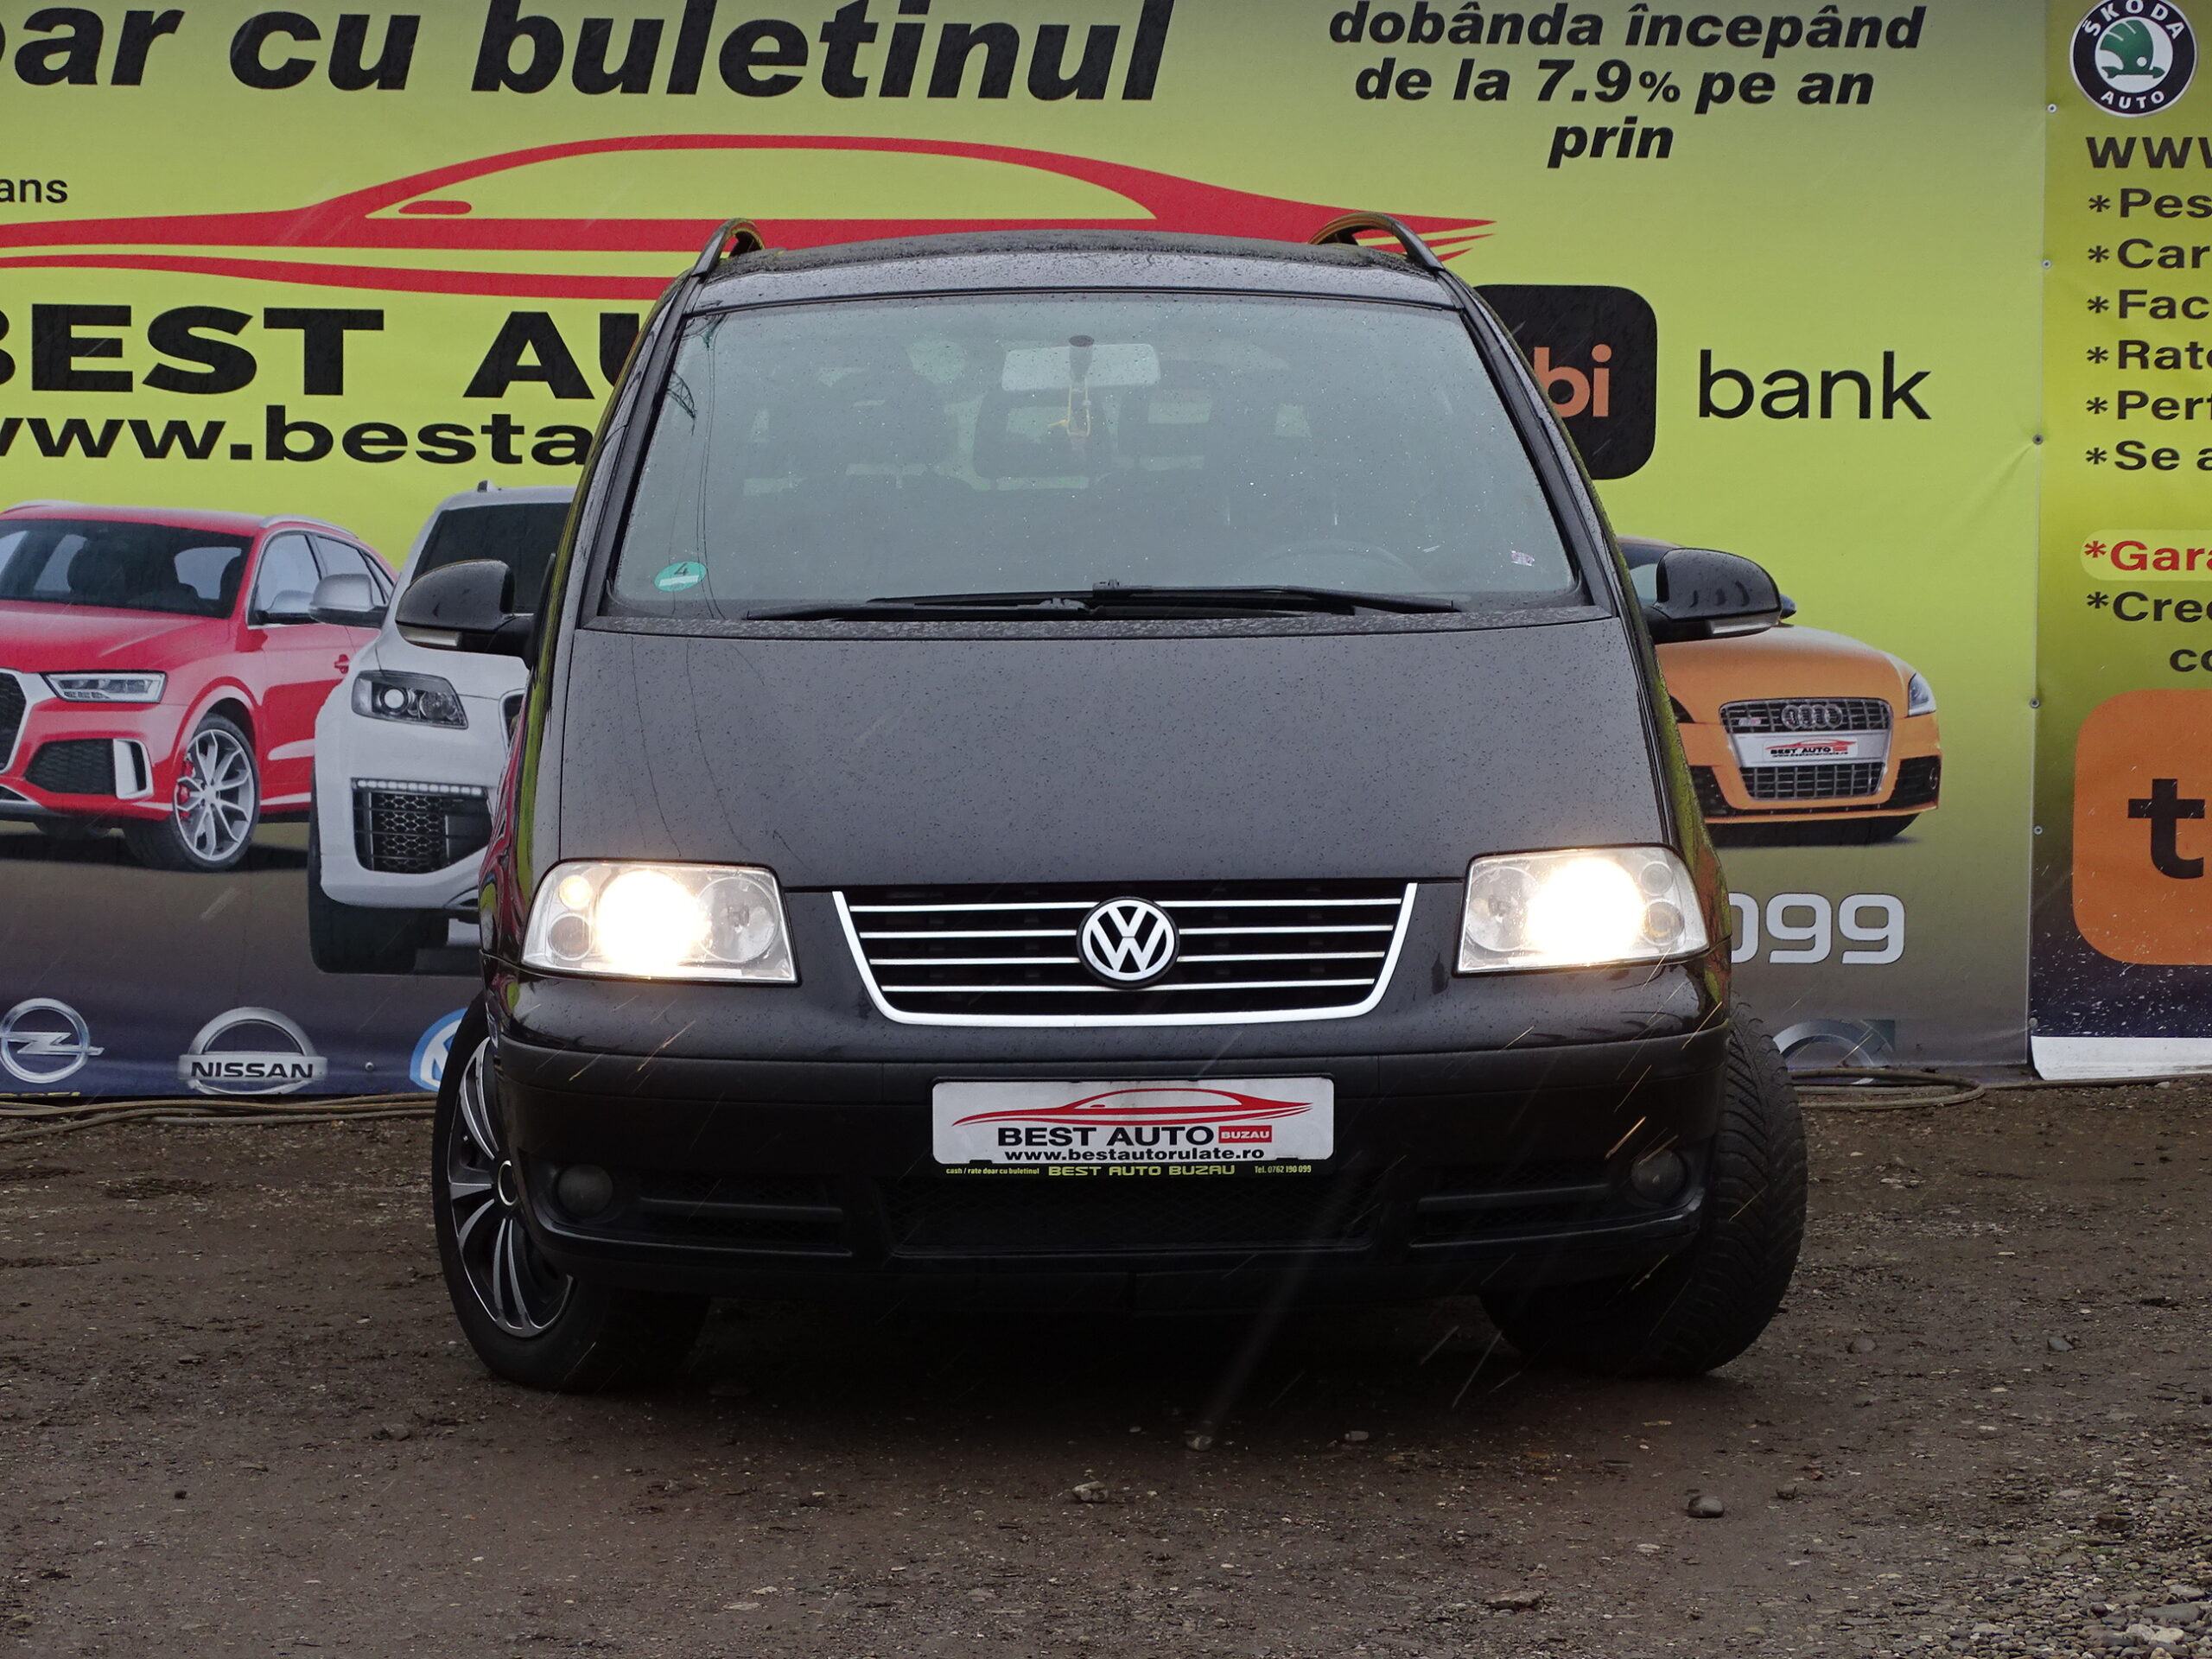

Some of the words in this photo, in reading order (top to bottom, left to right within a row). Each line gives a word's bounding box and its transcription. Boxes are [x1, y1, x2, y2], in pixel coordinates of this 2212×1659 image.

[1329, 1, 1604, 46] dobânda
[1625, 3, 1927, 58] începând
[2082, 0, 2185, 40] ŠKODA
[0, 7, 185, 86] ar
[230, 10, 421, 90] cu
[471, 0, 1173, 101] buletinul
[1355, 58, 1432, 101] de
[1452, 58, 1510, 101] la
[1536, 60, 1681, 104] 7.9%
[1694, 71, 1775, 114] pe
[1796, 72, 1874, 105] an
[2101, 90, 2165, 110] AUTO
[1547, 116, 1674, 168] prin
[2085, 136, 2212, 168] WW
[2086, 340, 2212, 370] Rat
[1699, 348, 1932, 420] bank
[2083, 540, 2212, 571] Gar
[2086, 591, 2212, 623] Cre
[2127, 778, 2206, 880] t
[1084, 901, 1173, 979] VW
[190, 1060, 315, 1079] NISSAN
[998, 1127, 1096, 1147] BEST
[1106, 1126, 1214, 1146] AUTO
[1220, 1130, 1270, 1140] BUZAU
[1004, 1147, 1265, 1160] www.bestautorulate.ro
[1048, 1166, 1102, 1176] BEST
[1109, 1166, 1162, 1176] AUTO
[1168, 1165, 1235, 1175] BUZAU
